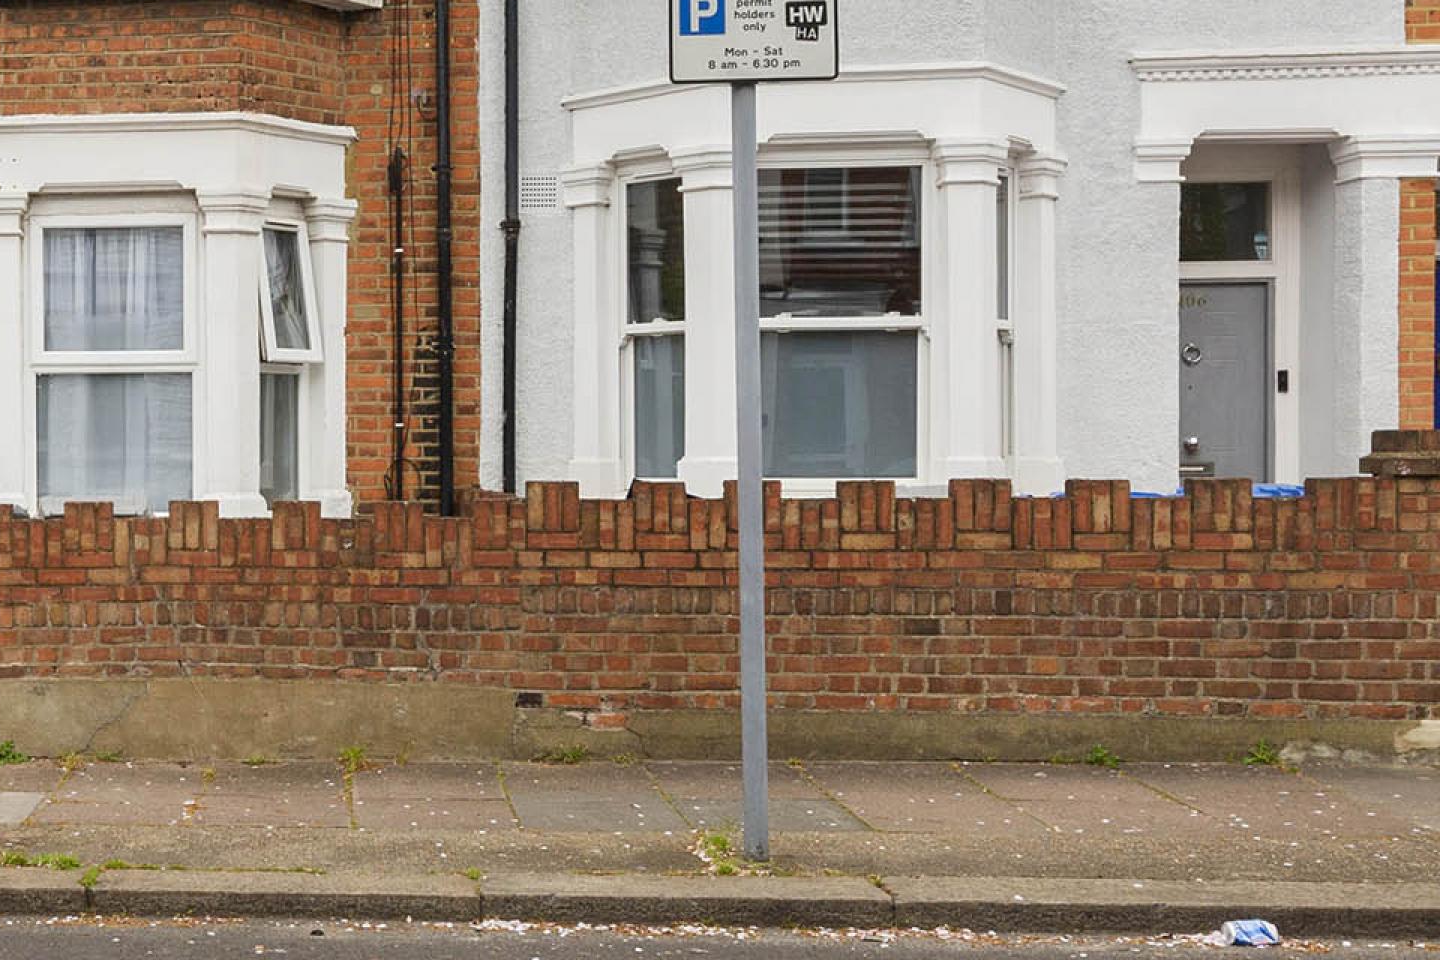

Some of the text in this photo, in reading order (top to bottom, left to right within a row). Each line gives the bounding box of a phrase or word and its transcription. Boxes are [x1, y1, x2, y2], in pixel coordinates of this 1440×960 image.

[734, 10, 776, 19] holders
[789, 5, 824, 24] HW
[743, 22, 767, 33] only
[796, 27, 817, 40] HA
[723, 47, 748, 57] Mon
[763, 46, 784, 56] Sat
[707, 59, 717, 70] 8
[720, 61, 738, 70] am
[782, 59, 801, 69] pm
